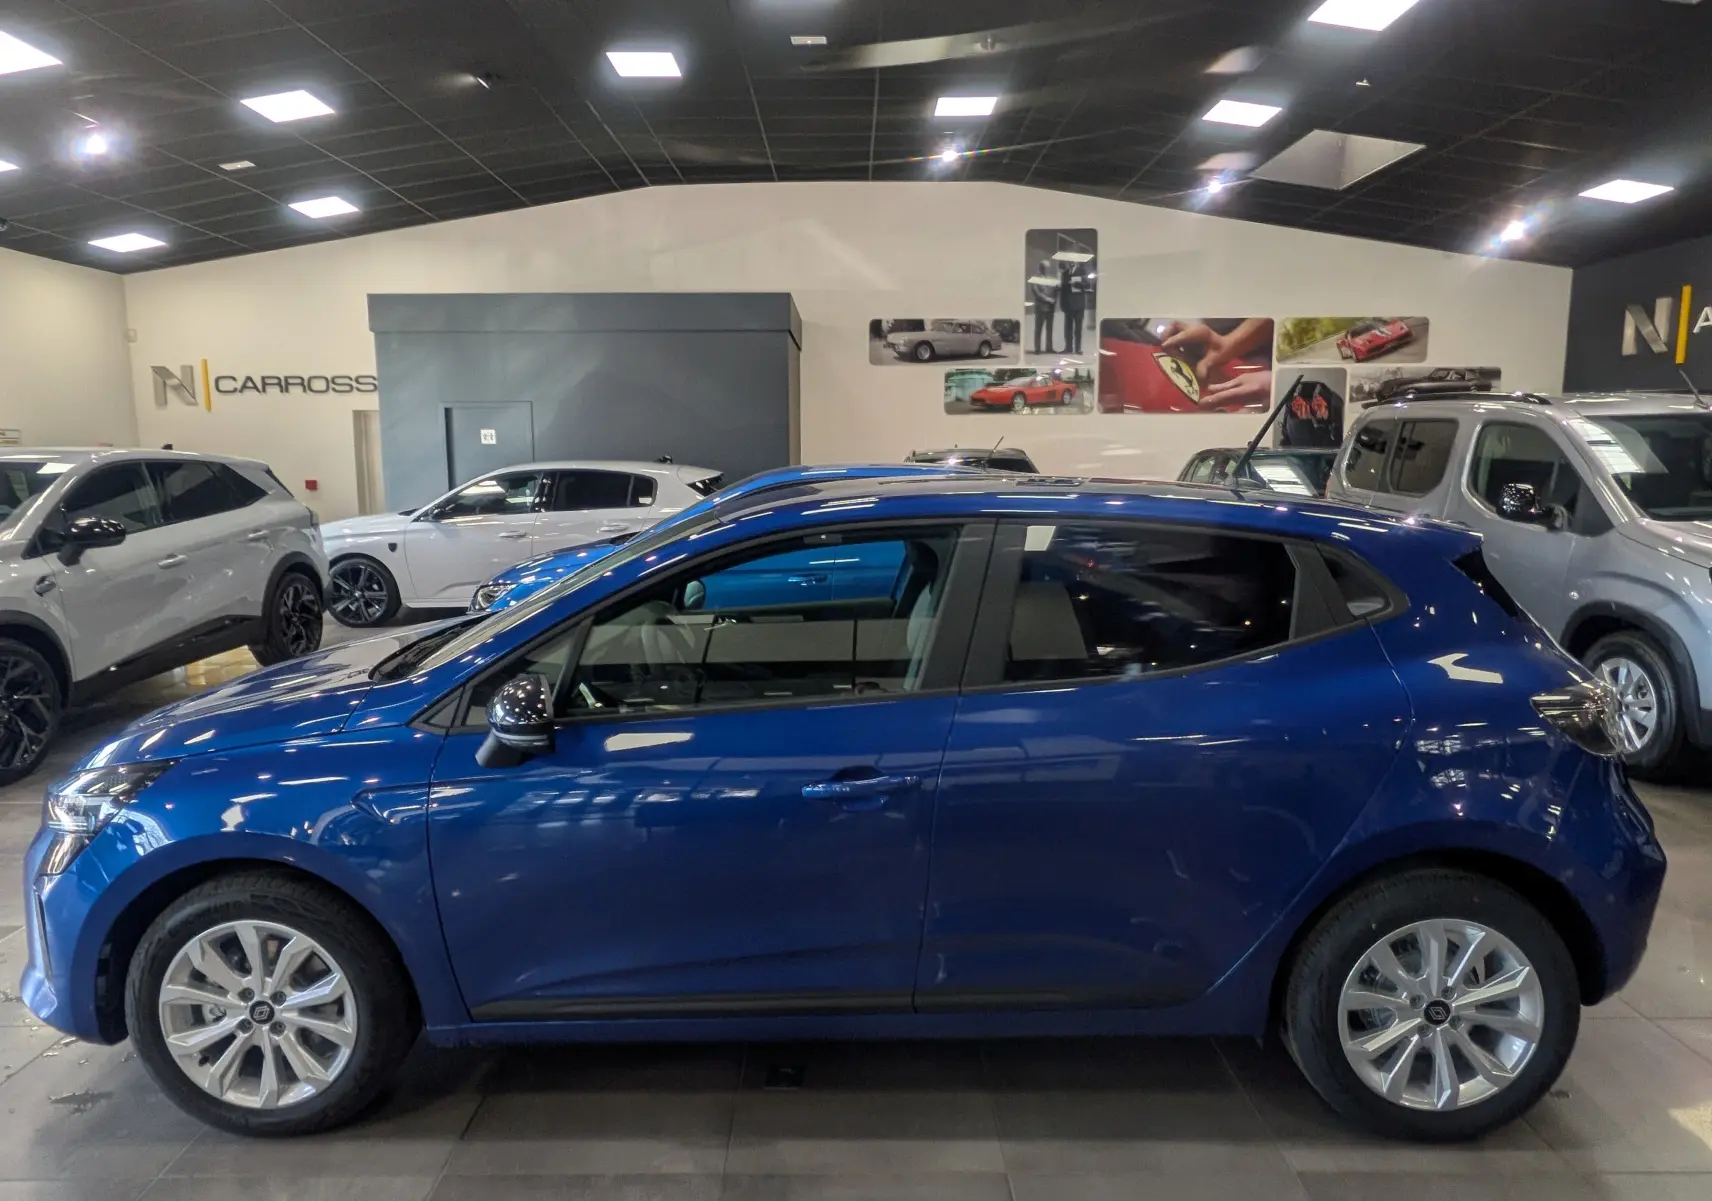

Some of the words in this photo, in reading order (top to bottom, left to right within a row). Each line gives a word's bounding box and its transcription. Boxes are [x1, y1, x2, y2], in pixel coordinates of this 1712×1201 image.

[1621, 297, 1673, 356] N
[151, 364, 199, 408] N
[214, 375, 378, 394] CARROSS
